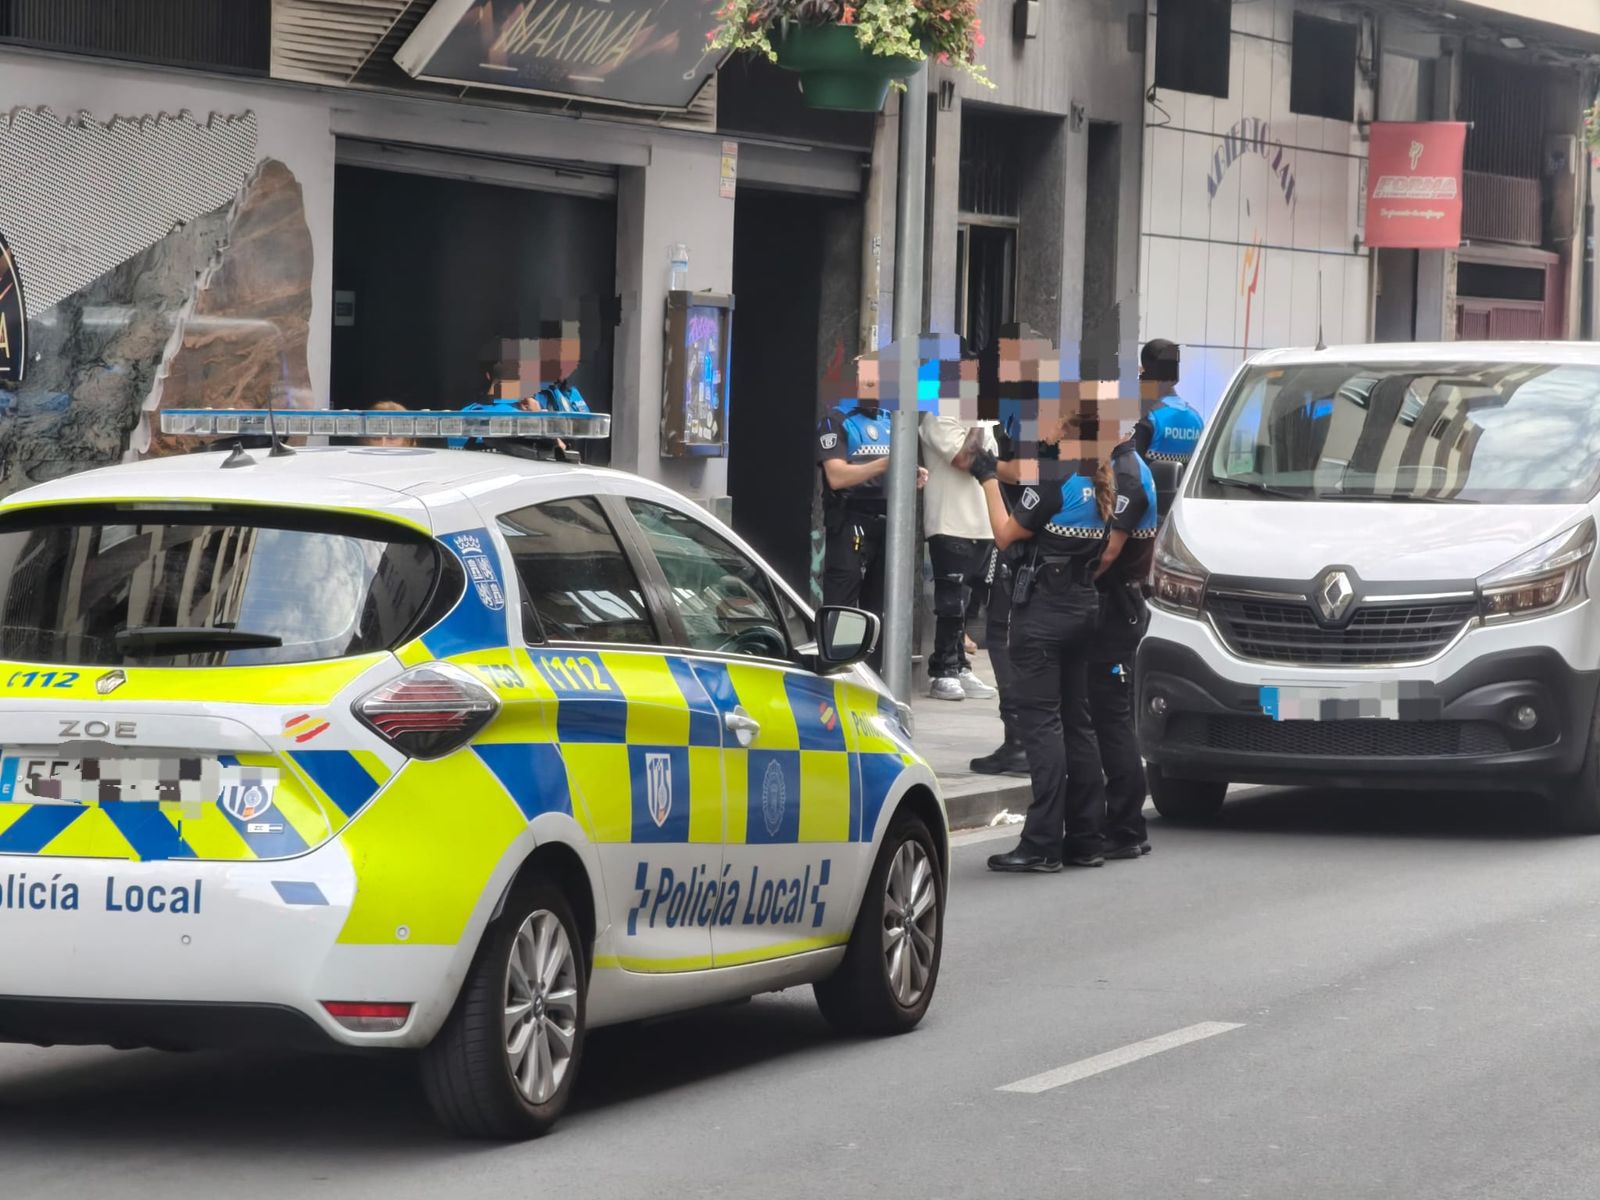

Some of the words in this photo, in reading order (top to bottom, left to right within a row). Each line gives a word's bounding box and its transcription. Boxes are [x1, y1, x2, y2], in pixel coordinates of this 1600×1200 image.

[493, 0, 653, 67] MAXIMA
[21, 672, 80, 688] 112
[551, 656, 612, 691] 112
[58, 720, 137, 738] ZOE
[105, 876, 203, 914] Local
[649, 863, 740, 929] Policía
[742, 864, 811, 925] Local
